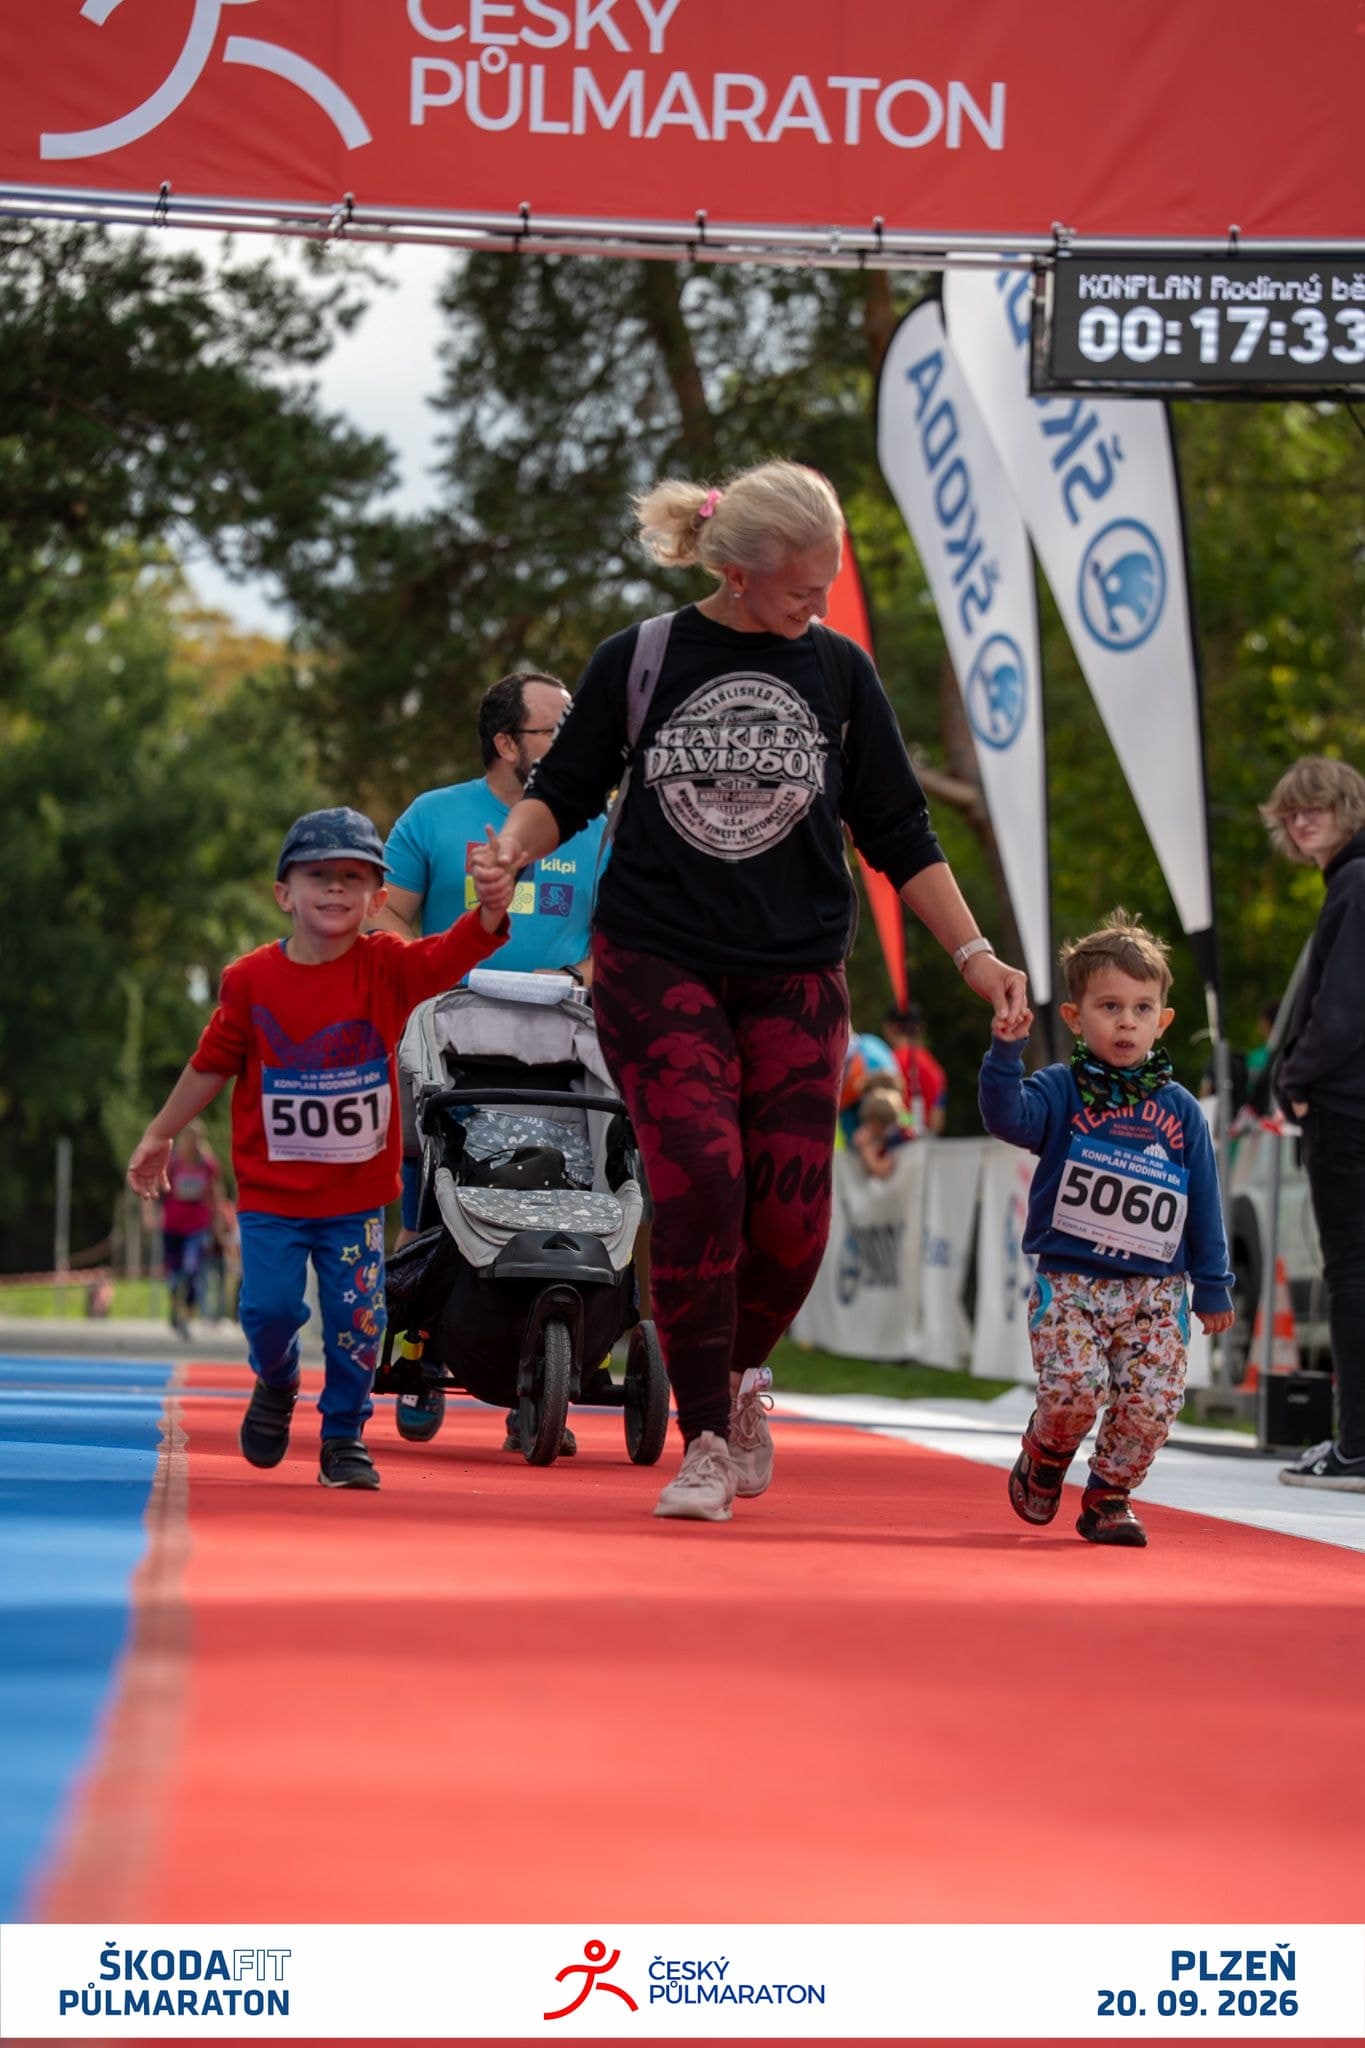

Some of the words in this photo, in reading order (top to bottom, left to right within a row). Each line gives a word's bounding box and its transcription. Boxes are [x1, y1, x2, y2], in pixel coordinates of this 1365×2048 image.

[410, 45, 1007, 151] PŮLMARATON
[1078, 274, 1202, 300] KONPLAN
[1210, 275, 1322, 304] Rodinný
[1078, 305, 1365, 364] 00:17:33
[644, 747, 829, 795] DAVIDSON
[541, 858, 576, 873] kilpi
[271, 1092, 379, 1138] 5061
[1081, 1148, 1127, 1169] KONPLAN
[1128, 1162, 1168, 1181] RODINNÝ
[1060, 1166, 1178, 1233] 5060
